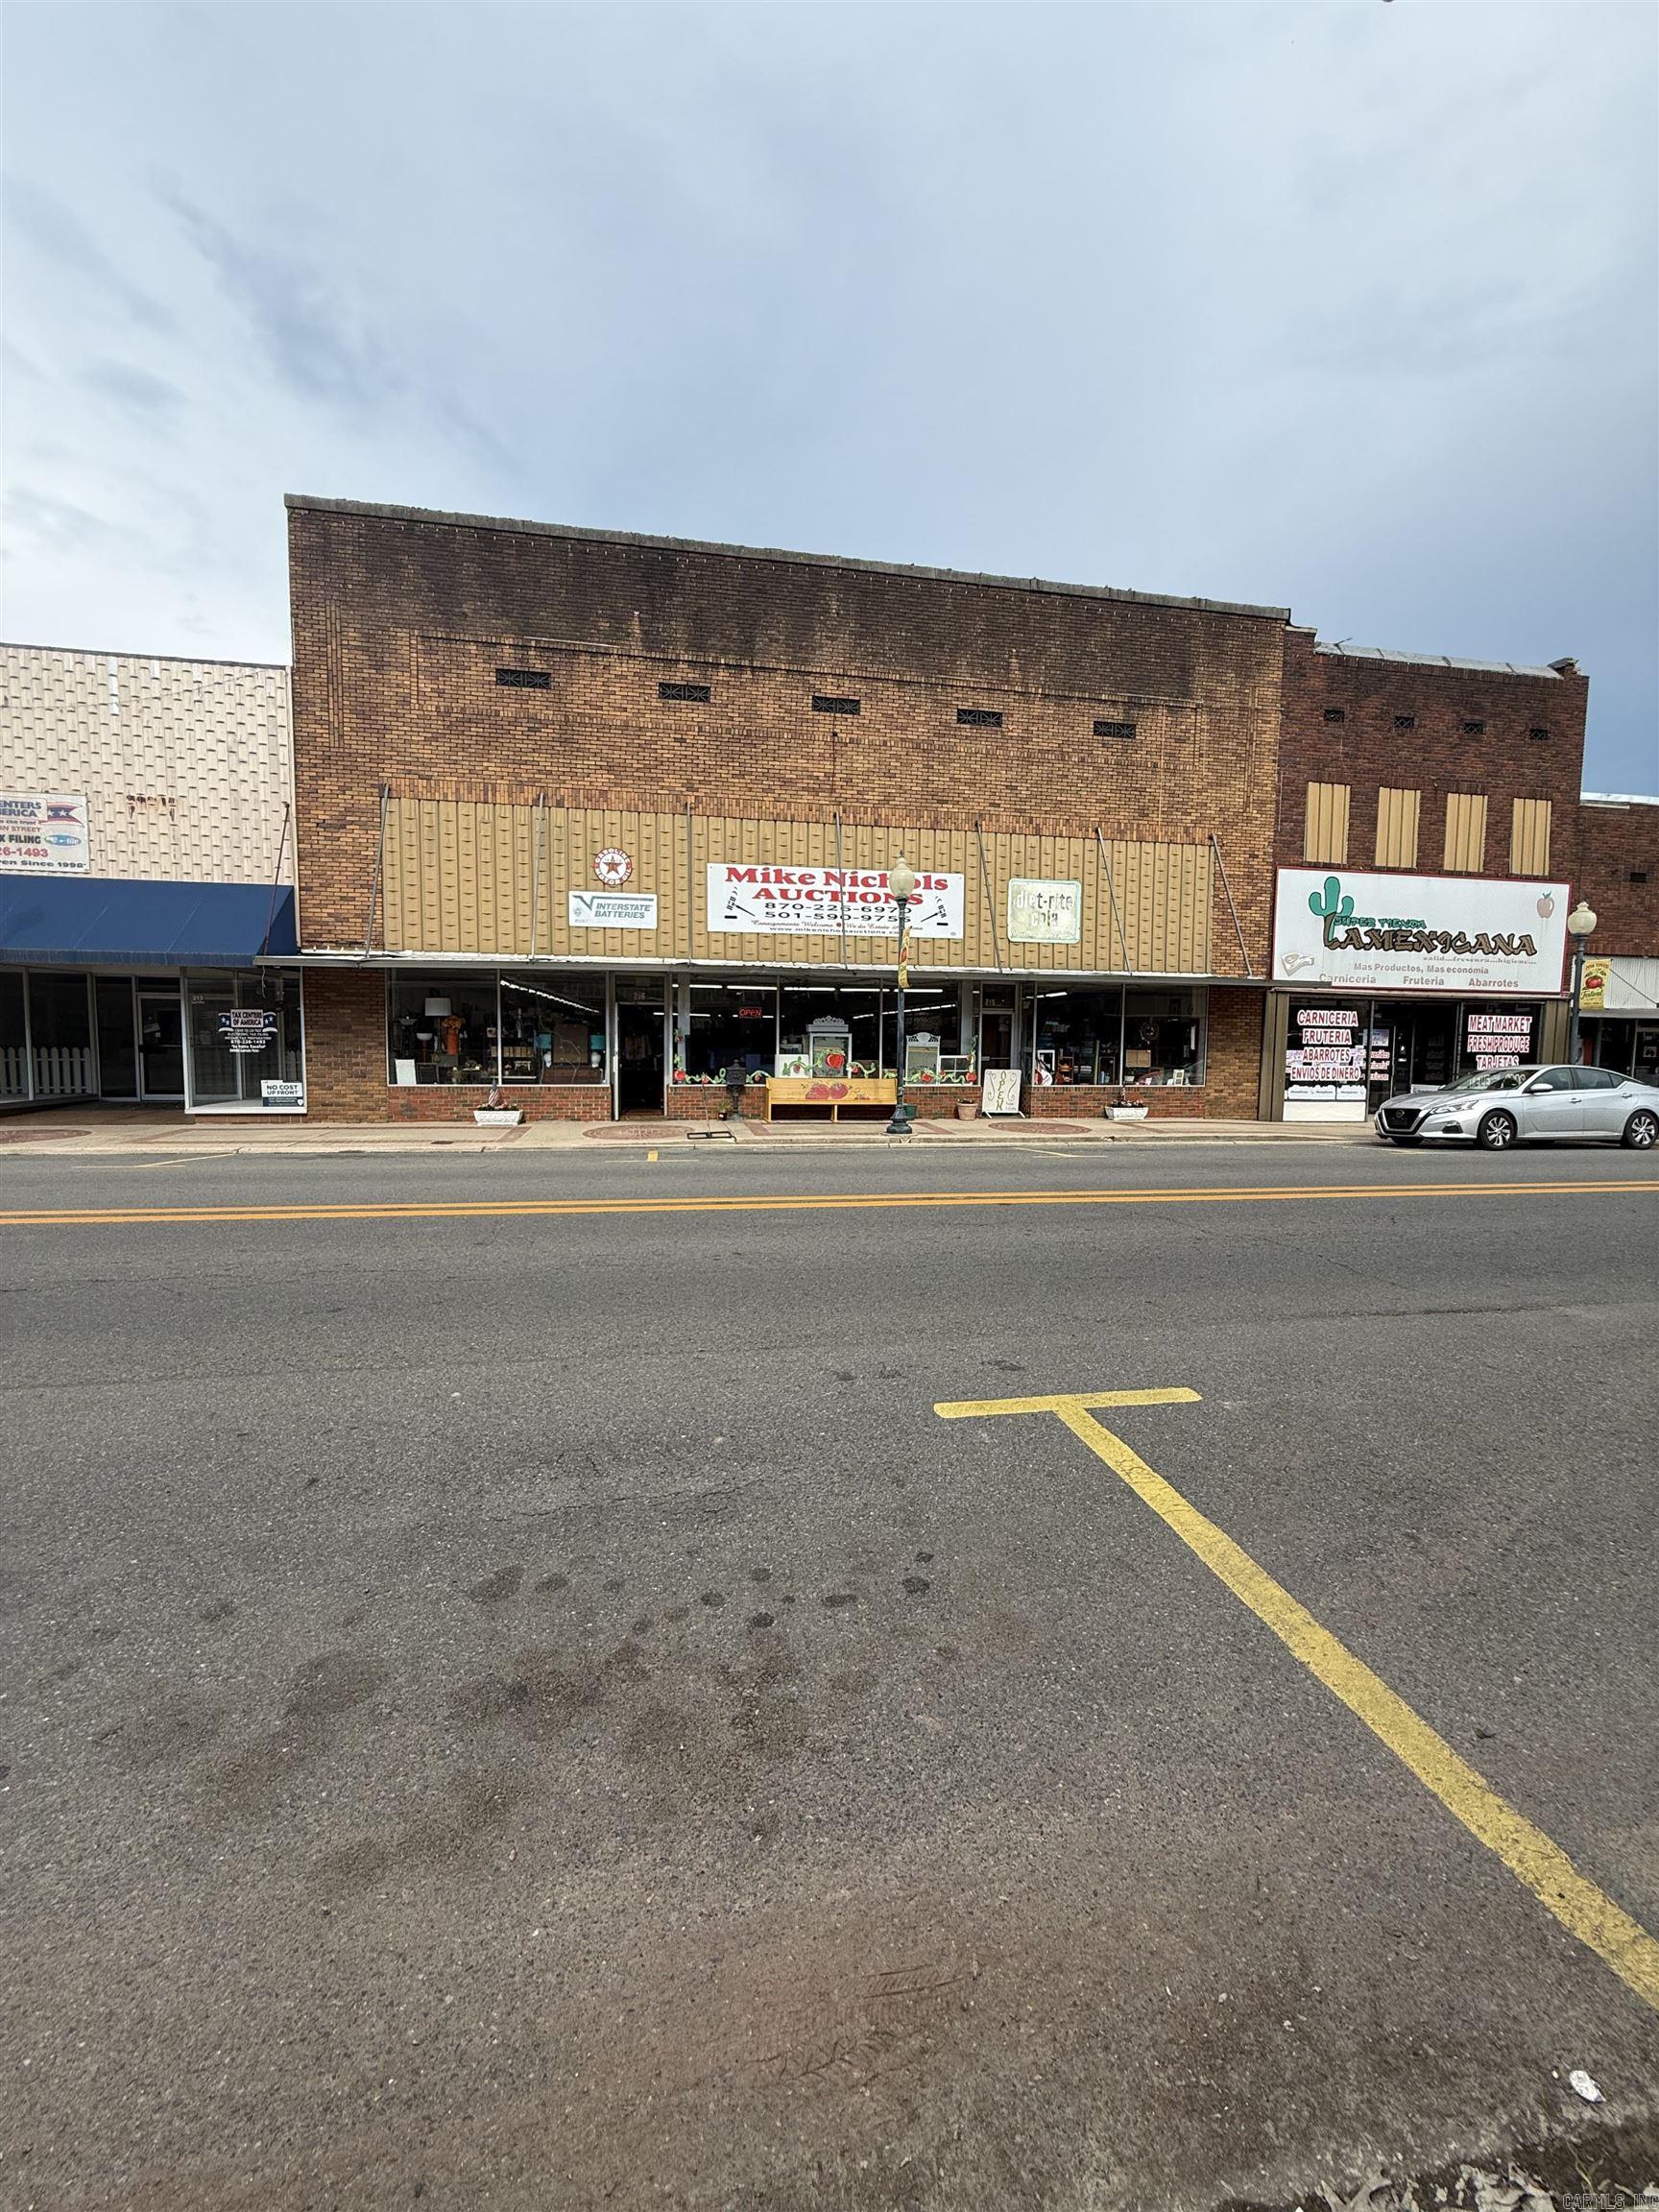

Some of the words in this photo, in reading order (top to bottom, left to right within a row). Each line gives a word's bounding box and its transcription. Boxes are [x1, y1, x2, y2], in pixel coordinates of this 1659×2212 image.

[0, 808, 37, 817] ERICA
[9, 835, 41, 844] FILING
[0, 847, 49, 857] 6-1493
[725, 867, 816, 885] Mike
[823, 871, 949, 891] Nicls
[752, 887, 924, 905] AUCTIONS
[596, 902, 651, 912] INTERSTATE
[594, 910, 645, 919] BATTERIES
[1334, 915, 1376, 927] SUPER
[1378, 918, 1427, 929] TIENDA
[1319, 973, 1377, 984] Carniceria
[1403, 975, 1444, 985] Fruteria
[1468, 977, 1519, 988] Abarrotes
[1298, 1011, 1358, 1025] CARNICERIA
[1469, 1016, 1493, 1031] MEAT
[1494, 1016, 1532, 1032] MARKET
[1303, 1029, 1352, 1044] FRUTERIA
[1468, 1035, 1493, 1051] FRESH
[1494, 1036, 1529, 1052] PRODUCE
[1303, 1048, 1351, 1062] ABARROTES
[1477, 1056, 1519, 1070] TARJETAS
[1291, 1067, 1319, 1079] ENVIOS
[1321, 1067, 1331, 1079] DE
[1332, 1067, 1359, 1080] DINERO
